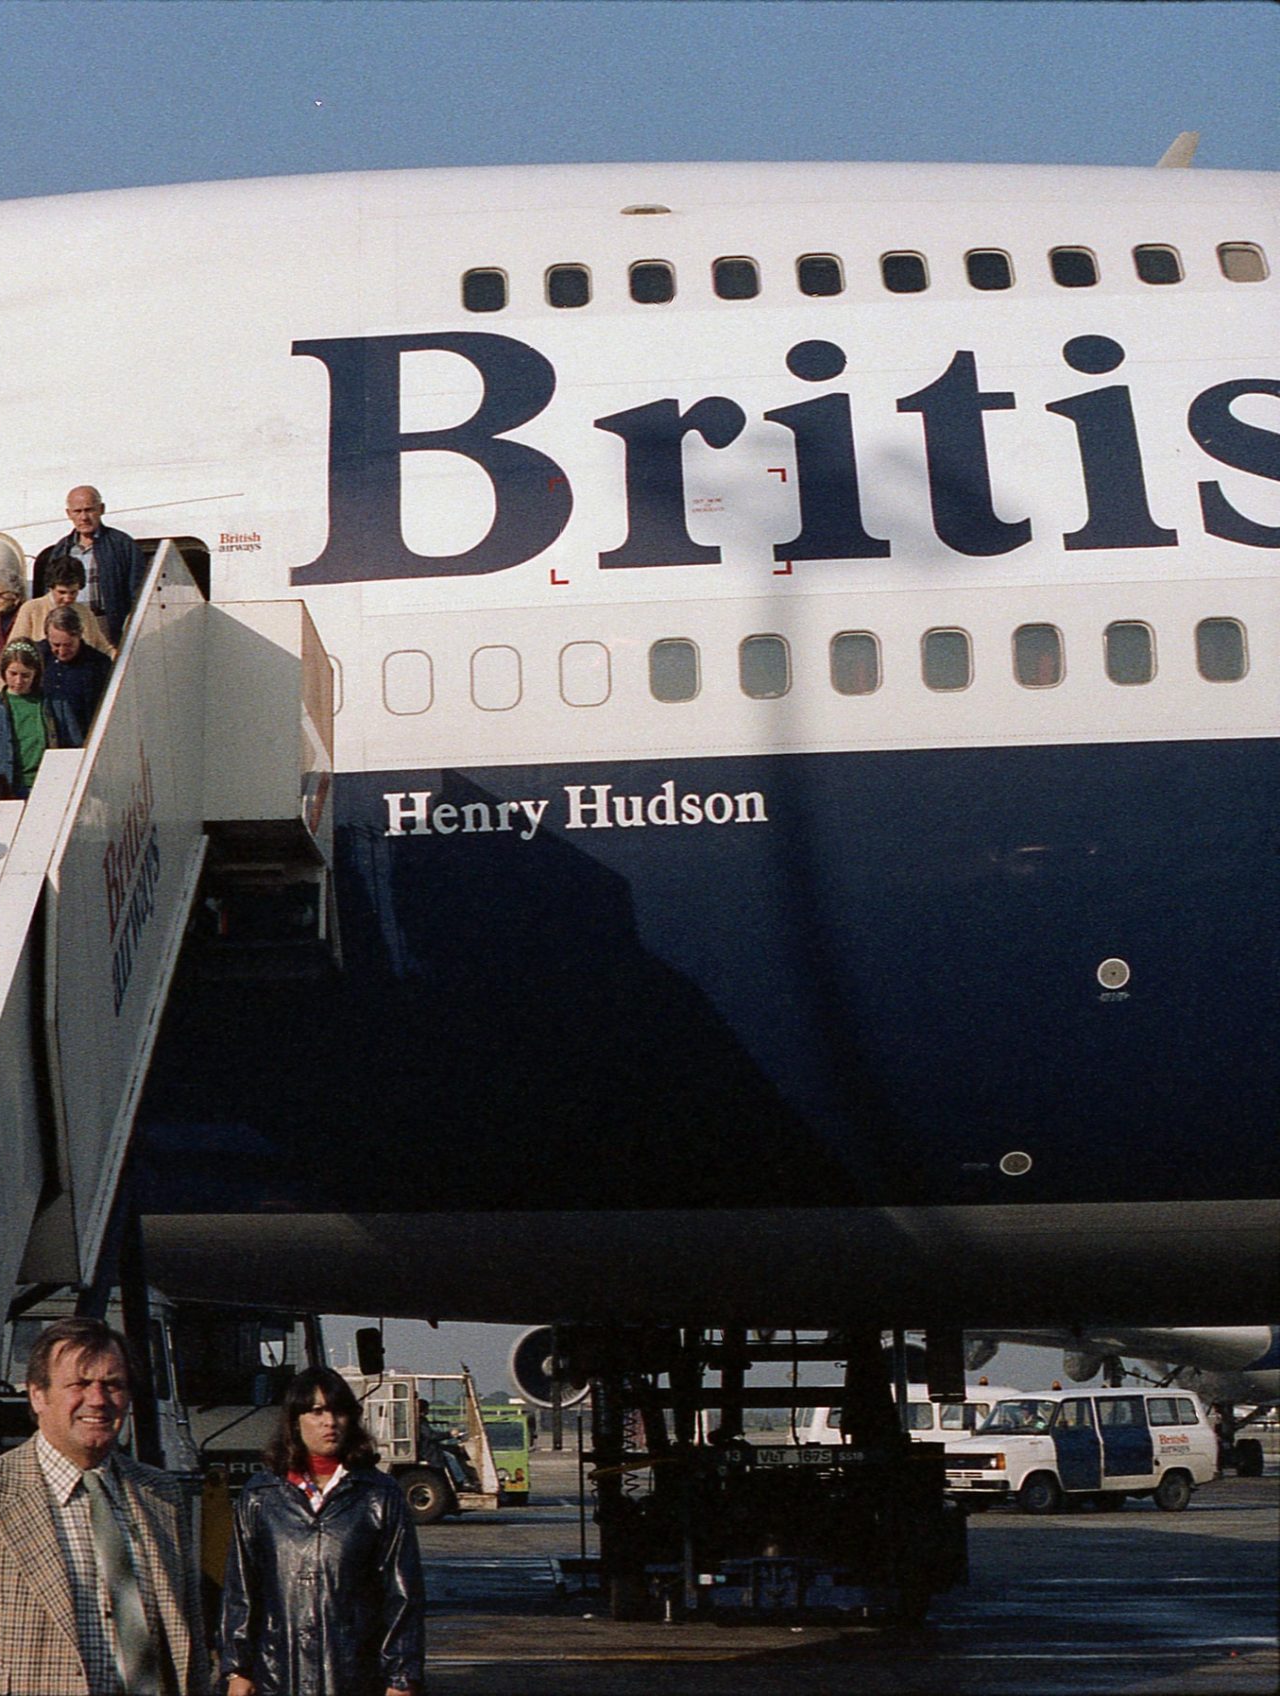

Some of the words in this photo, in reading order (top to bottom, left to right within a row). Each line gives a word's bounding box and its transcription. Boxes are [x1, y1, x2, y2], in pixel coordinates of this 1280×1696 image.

[220, 532, 261, 544] British
[383, 792, 549, 840] Henry
[564, 781, 769, 829] Hudson
